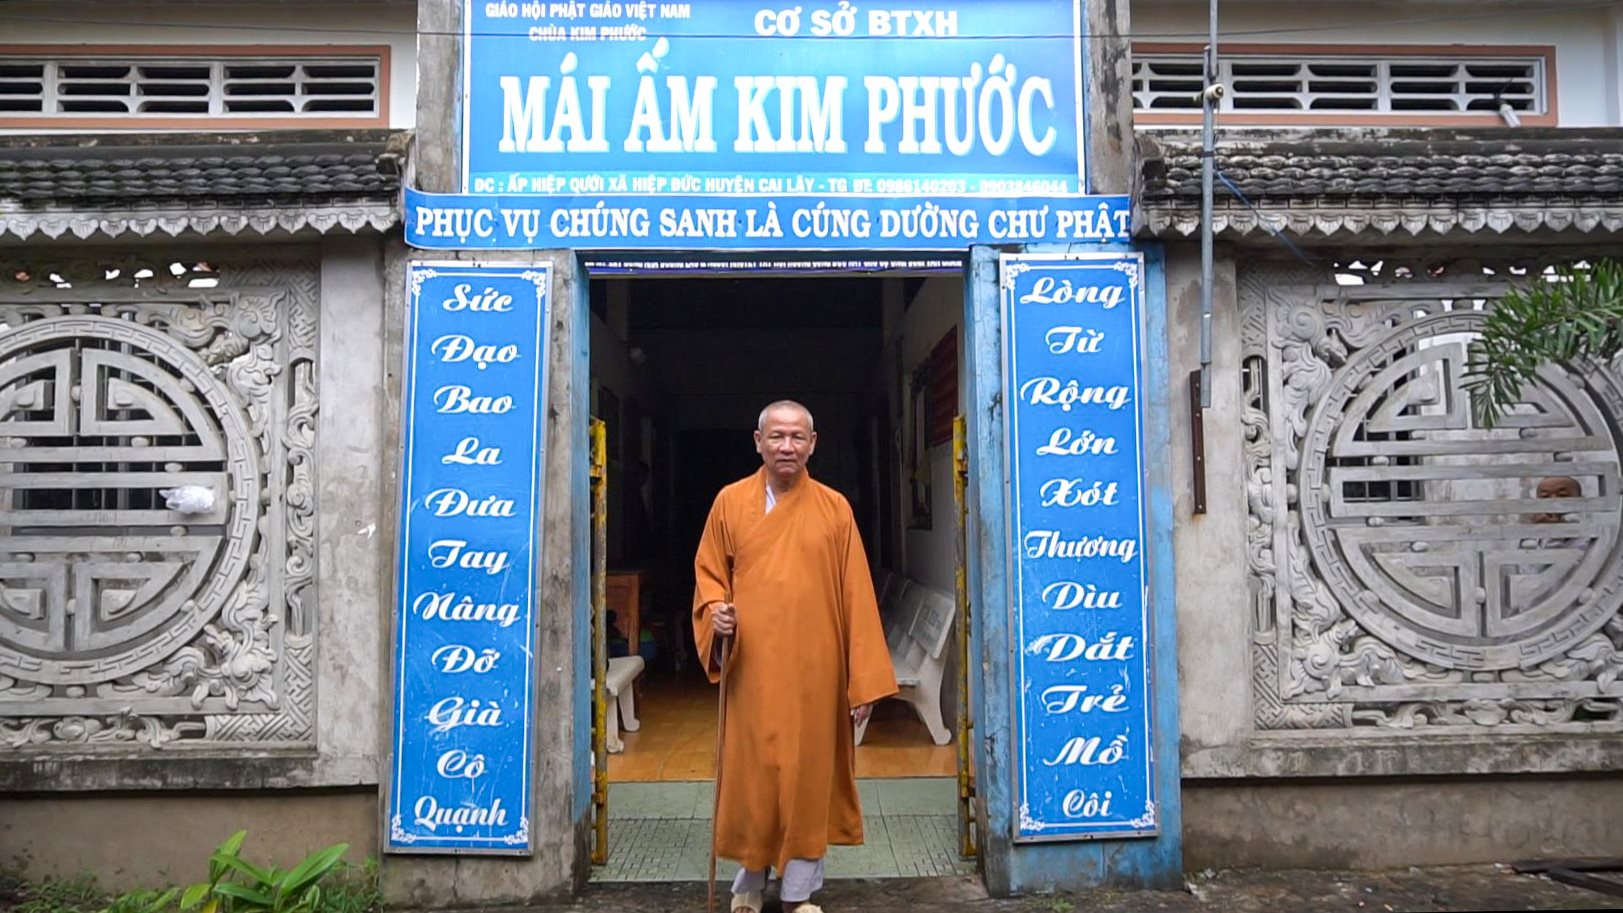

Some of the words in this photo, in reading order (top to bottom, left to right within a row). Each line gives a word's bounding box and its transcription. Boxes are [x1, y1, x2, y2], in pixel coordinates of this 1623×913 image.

[485, 3, 518, 18] GIÁO
[521, 4, 546, 20] HỘI
[550, 3, 585, 20] PHẬT
[589, 3, 622, 18] GIÁO
[625, 1, 656, 20] VIỆT
[660, 5, 691, 18] NAM
[754, 6, 803, 36] CƠ
[810, 0, 858, 36] SỞ
[868, 10, 958, 36] BTXH
[528, 24, 566, 41] CHÙA
[570, 27, 596, 41] KIM
[600, 23, 648, 41] PHƯỚC
[498, 51, 611, 154] MÁI
[624, 36, 718, 154] ẤM
[734, 75, 849, 154] KIM
[863, 52, 1058, 157] PHƯỚC
[531, 173, 566, 194] HIỆP
[608, 172, 628, 193] XÃ
[632, 173, 667, 194] HIỆP
[705, 174, 755, 194] HUYỆN
[758, 178, 782, 193] CAI
[827, 178, 848, 193] TG
[415, 206, 494, 244] PHỤC
[500, 209, 541, 244] VỤ
[550, 201, 650, 238] CHÚNG
[659, 208, 738, 238] SANH
[745, 201, 784, 238] LÀ
[792, 201, 872, 238] CÚNG
[880, 201, 979, 238] DƯỜNG
[988, 205, 1049, 238] CHƯ
[1056, 202, 1130, 242] PHẬT
[442, 283, 513, 312] Sức
[1019, 276, 1126, 309] Lòng
[431, 334, 522, 370] Đạo
[1045, 326, 1105, 354] Từ
[433, 385, 516, 414] Bao
[1020, 376, 1132, 411] Rộng
[441, 437, 503, 465] La
[1036, 427, 1120, 455] Lớn
[425, 488, 517, 517] Đưa
[1040, 478, 1119, 507] Xót
[428, 539, 510, 575] Tay
[1024, 530, 1138, 563] Thương
[413, 591, 521, 628] Nâng
[1042, 581, 1123, 610] Dìu
[431, 644, 500, 673] Đỡ
[1033, 632, 1134, 662] Dắt
[1041, 685, 1130, 714] Trẻ
[424, 696, 504, 737] Già
[437, 749, 486, 778] Cô
[1043, 735, 1130, 766] Mồ
[414, 795, 509, 833] Quạnh
[1062, 789, 1113, 819] Côi
